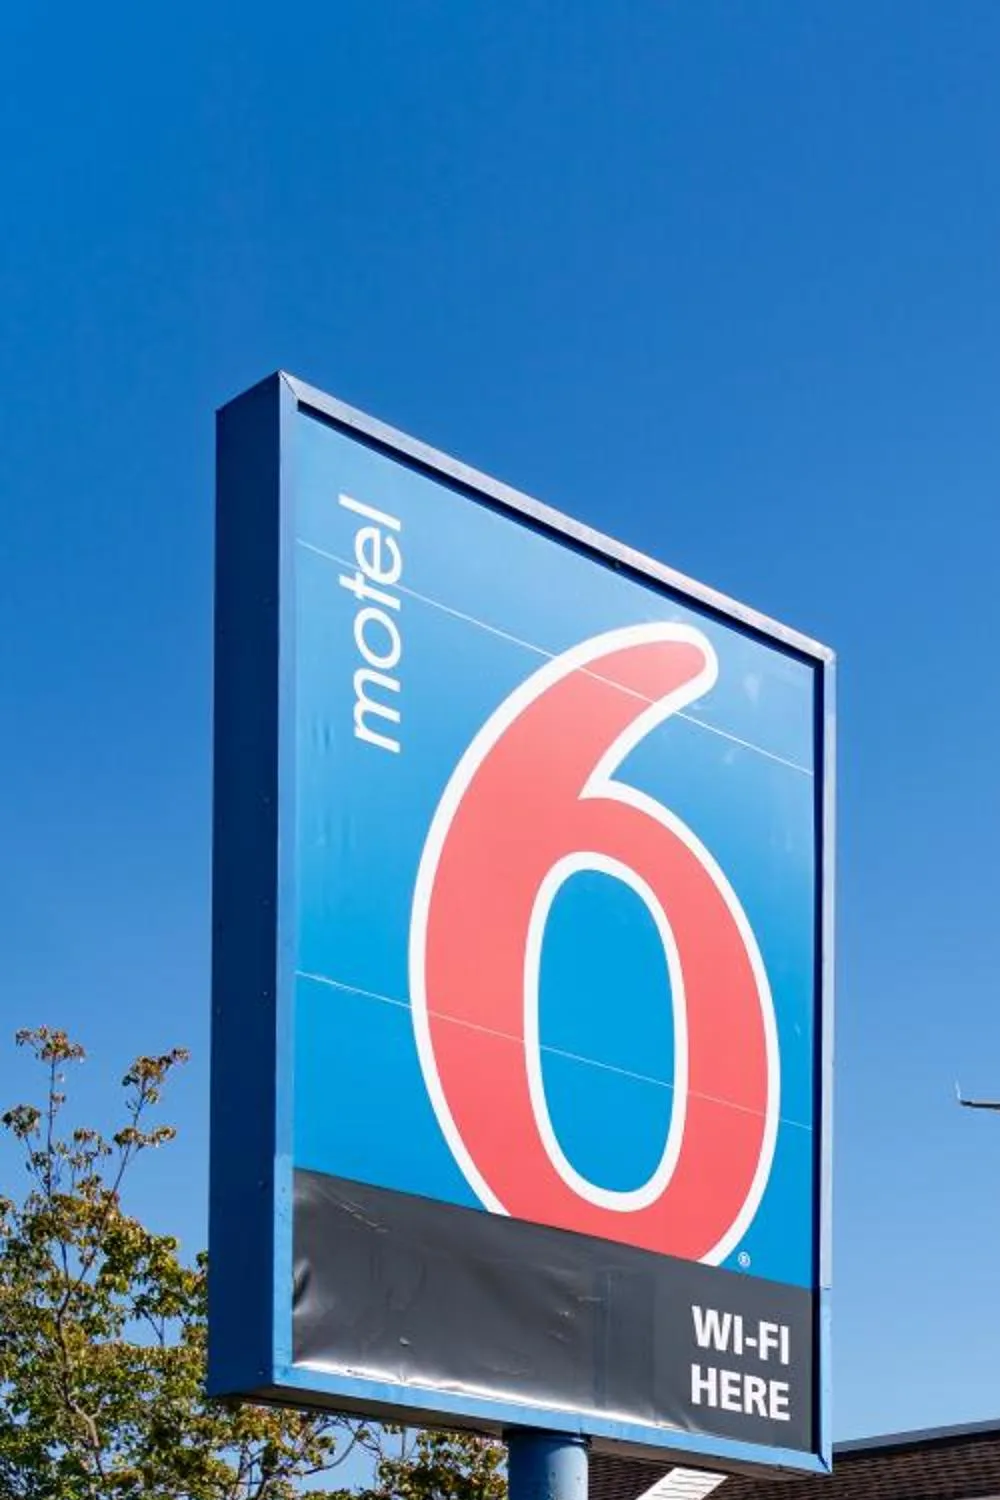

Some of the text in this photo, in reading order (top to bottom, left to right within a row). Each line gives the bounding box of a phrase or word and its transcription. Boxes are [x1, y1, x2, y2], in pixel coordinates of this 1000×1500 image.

[338, 493, 402, 753] motel
[408, 621, 781, 1267] 6
[691, 1305, 790, 1365] WI-FI
[691, 1363, 791, 1422] HERE
